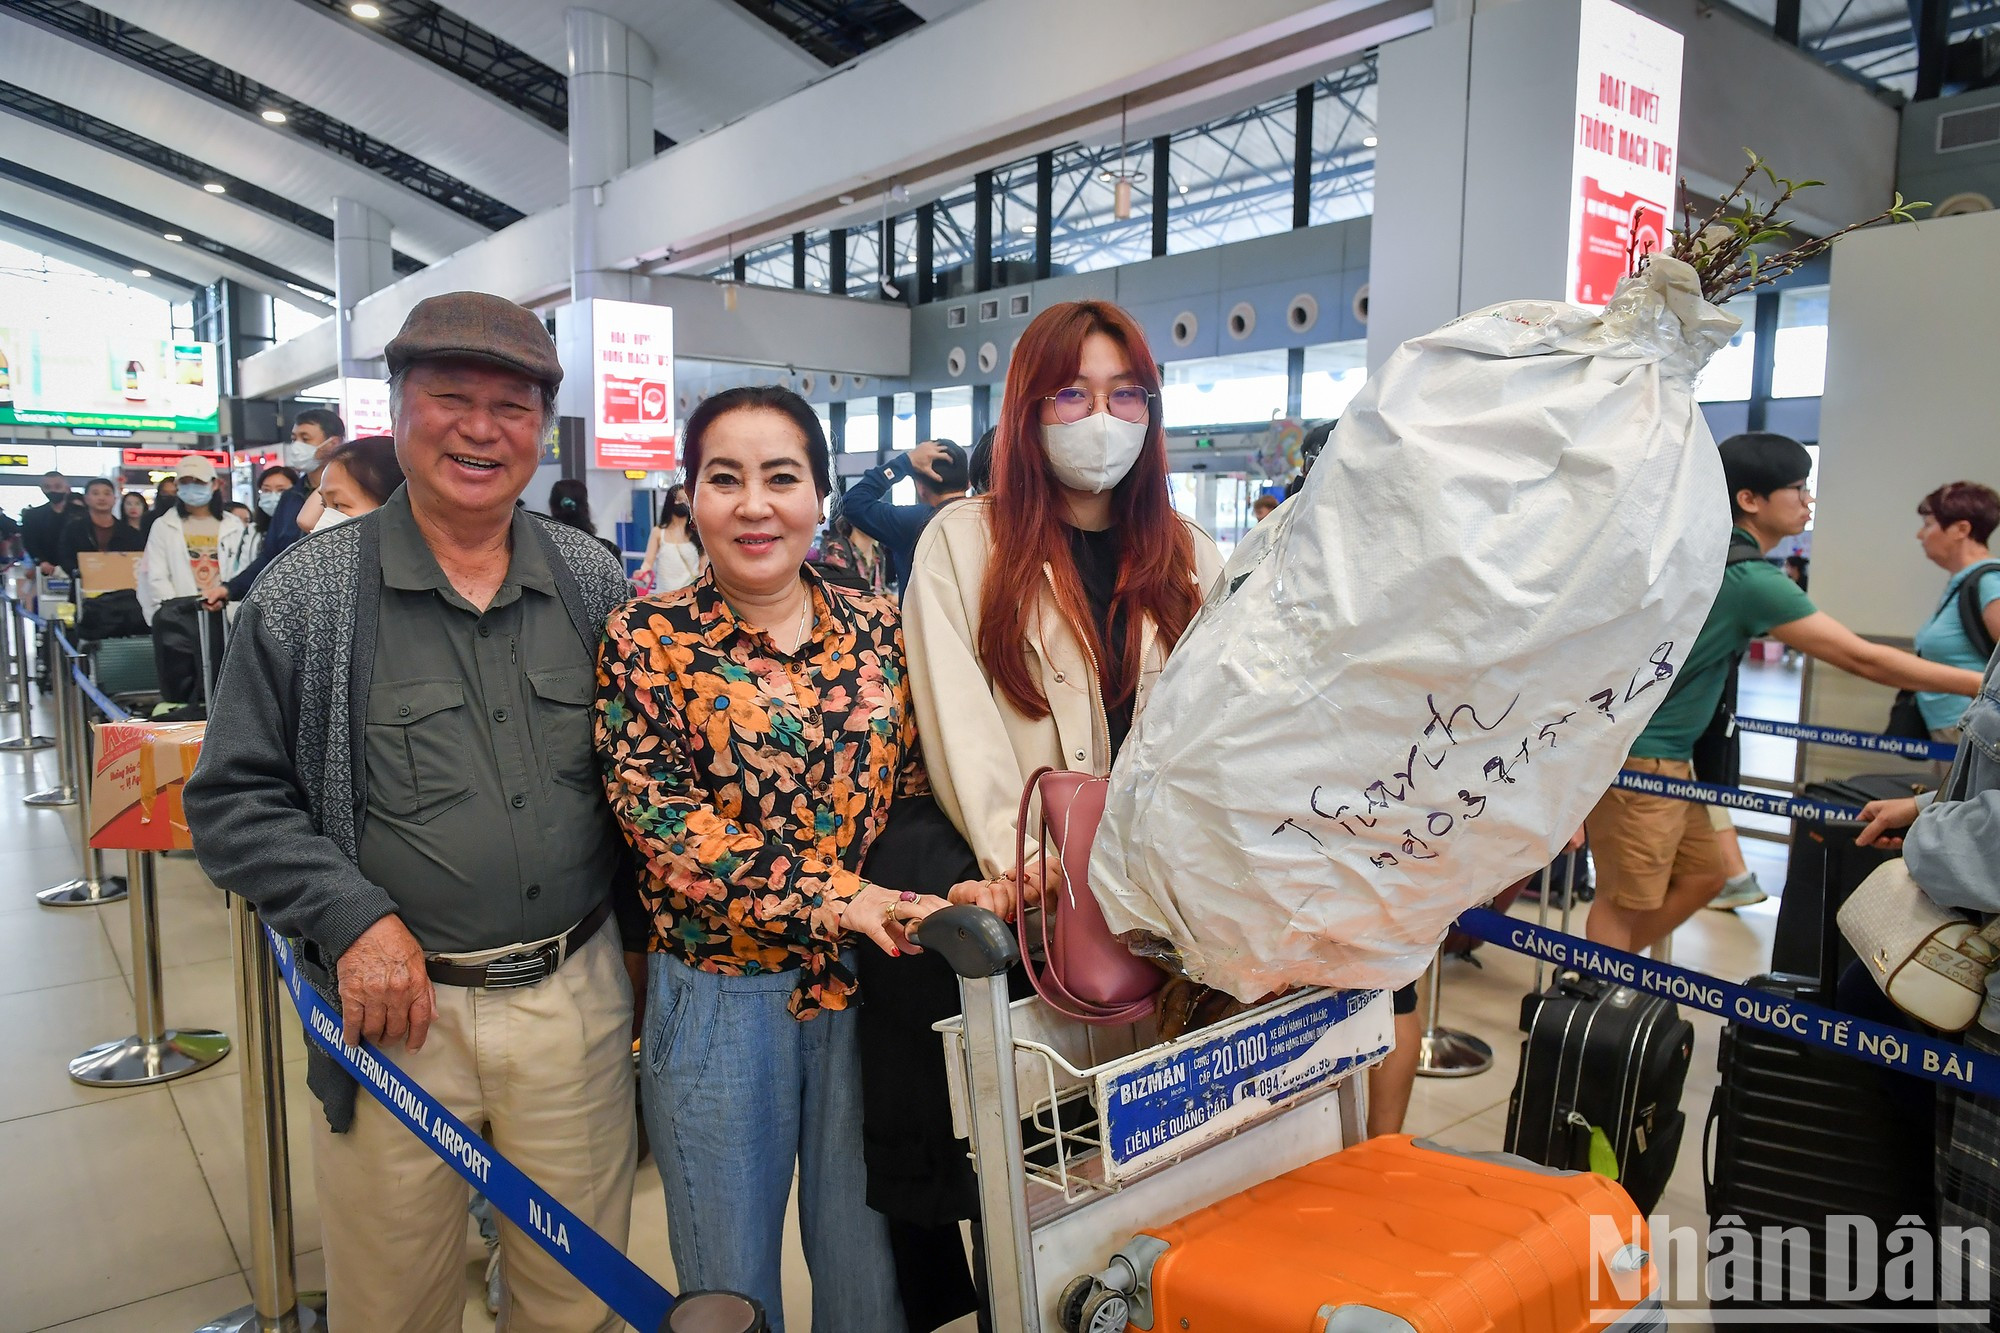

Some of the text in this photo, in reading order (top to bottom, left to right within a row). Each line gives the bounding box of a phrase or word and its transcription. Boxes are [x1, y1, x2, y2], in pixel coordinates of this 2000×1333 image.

[1652, 141, 1672, 176] TW3
[1776, 726, 1819, 741] KHÔNG
[1822, 731, 1857, 747] QUỐC
[1861, 734, 1876, 748] TẾ
[1623, 774, 1664, 793] HÀNG
[1666, 783, 1718, 803] KHÔNG
[1721, 792, 1764, 810] QUỐC
[1768, 799, 1788, 816] TẾ
[1511, 929, 1974, 1083] CẢNG HÀNG KHÔNG QUỐC TẾ NỘI BÀI
[1211, 1032, 1268, 1080] 20.000
[1120, 1062, 1186, 1106] BIZMAN
[344, 1044, 430, 1133] INTERNATIONAL
[431, 1116, 492, 1184] AIRPORT
[1125, 1127, 1150, 1156] LIÊN
[1152, 1119, 1169, 1143] HỆ
[529, 1198, 571, 1254] N.I.A
